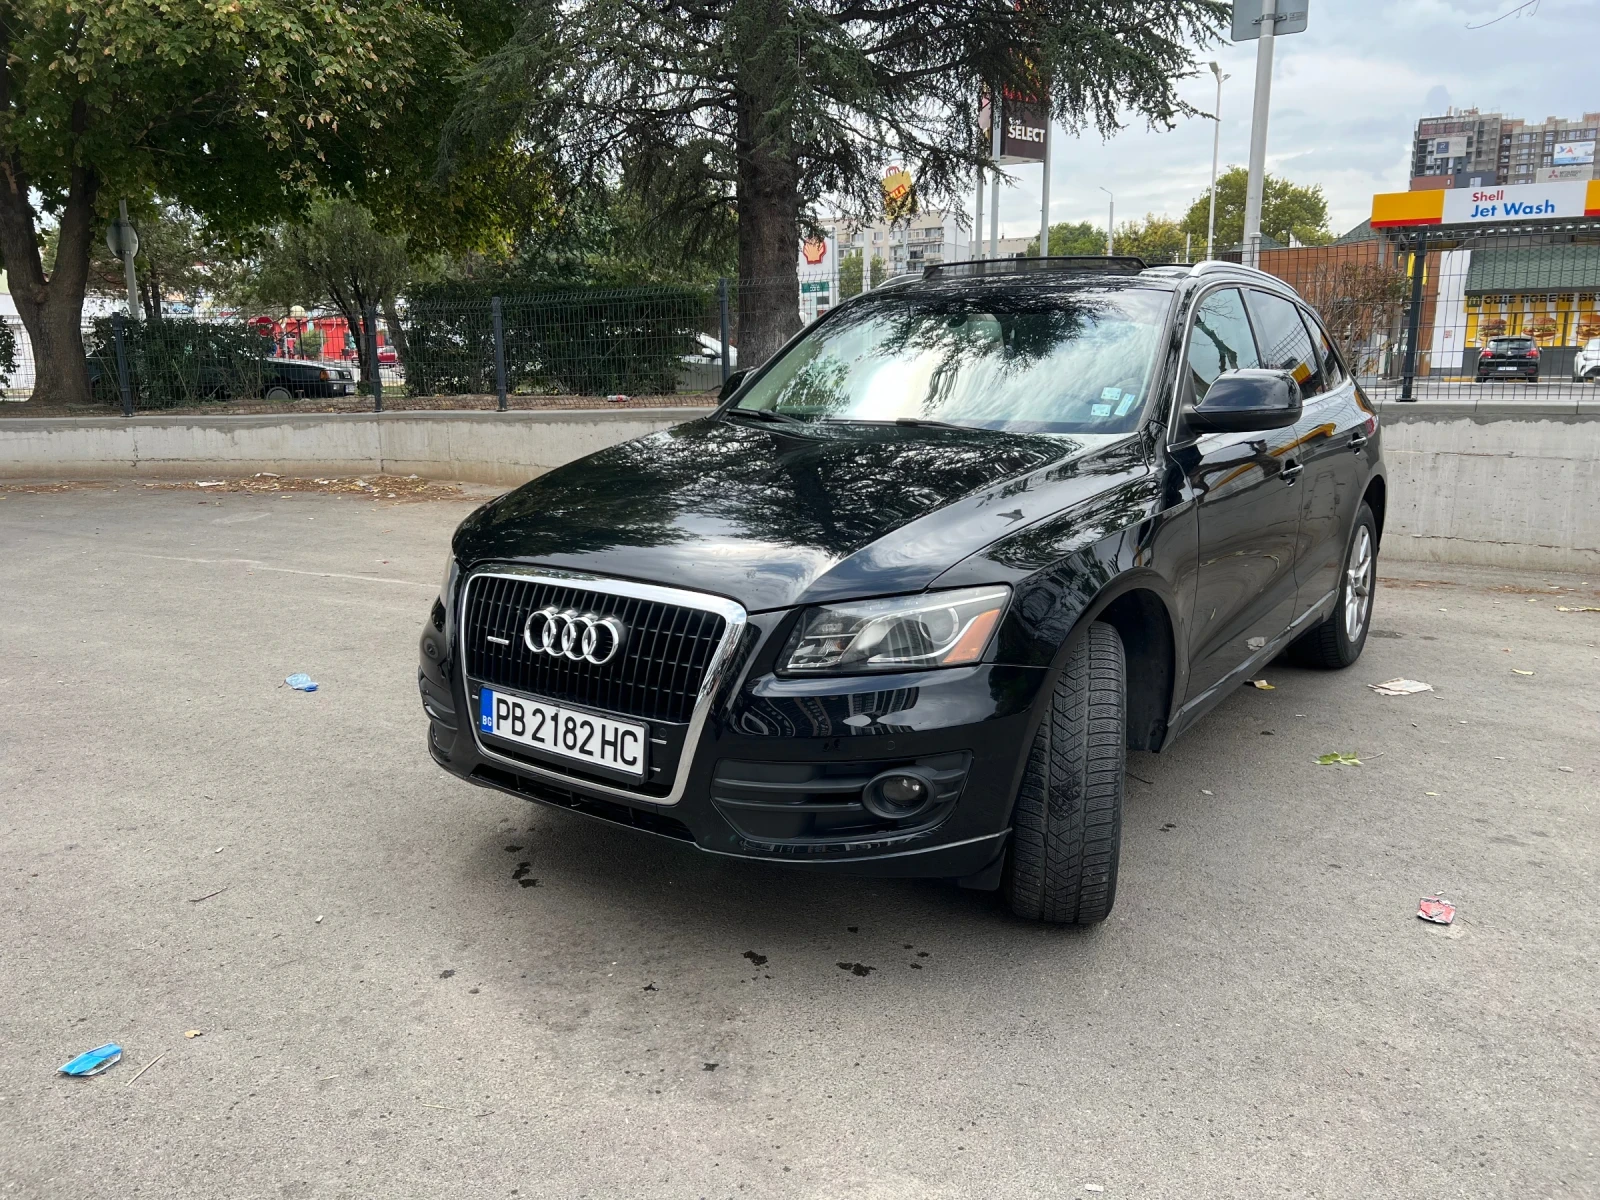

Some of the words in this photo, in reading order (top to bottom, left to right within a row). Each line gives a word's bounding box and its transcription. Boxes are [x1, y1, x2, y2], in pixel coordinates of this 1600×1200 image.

[1007, 125, 1045, 143] SELECT
[1472, 190, 1504, 202] Shell
[1471, 205, 1497, 217] Jet
[1503, 199, 1556, 216] Wash
[482, 715, 492, 726] BG
[496, 697, 526, 737] PB
[531, 707, 595, 757] 2182
[600, 723, 638, 766] HC
